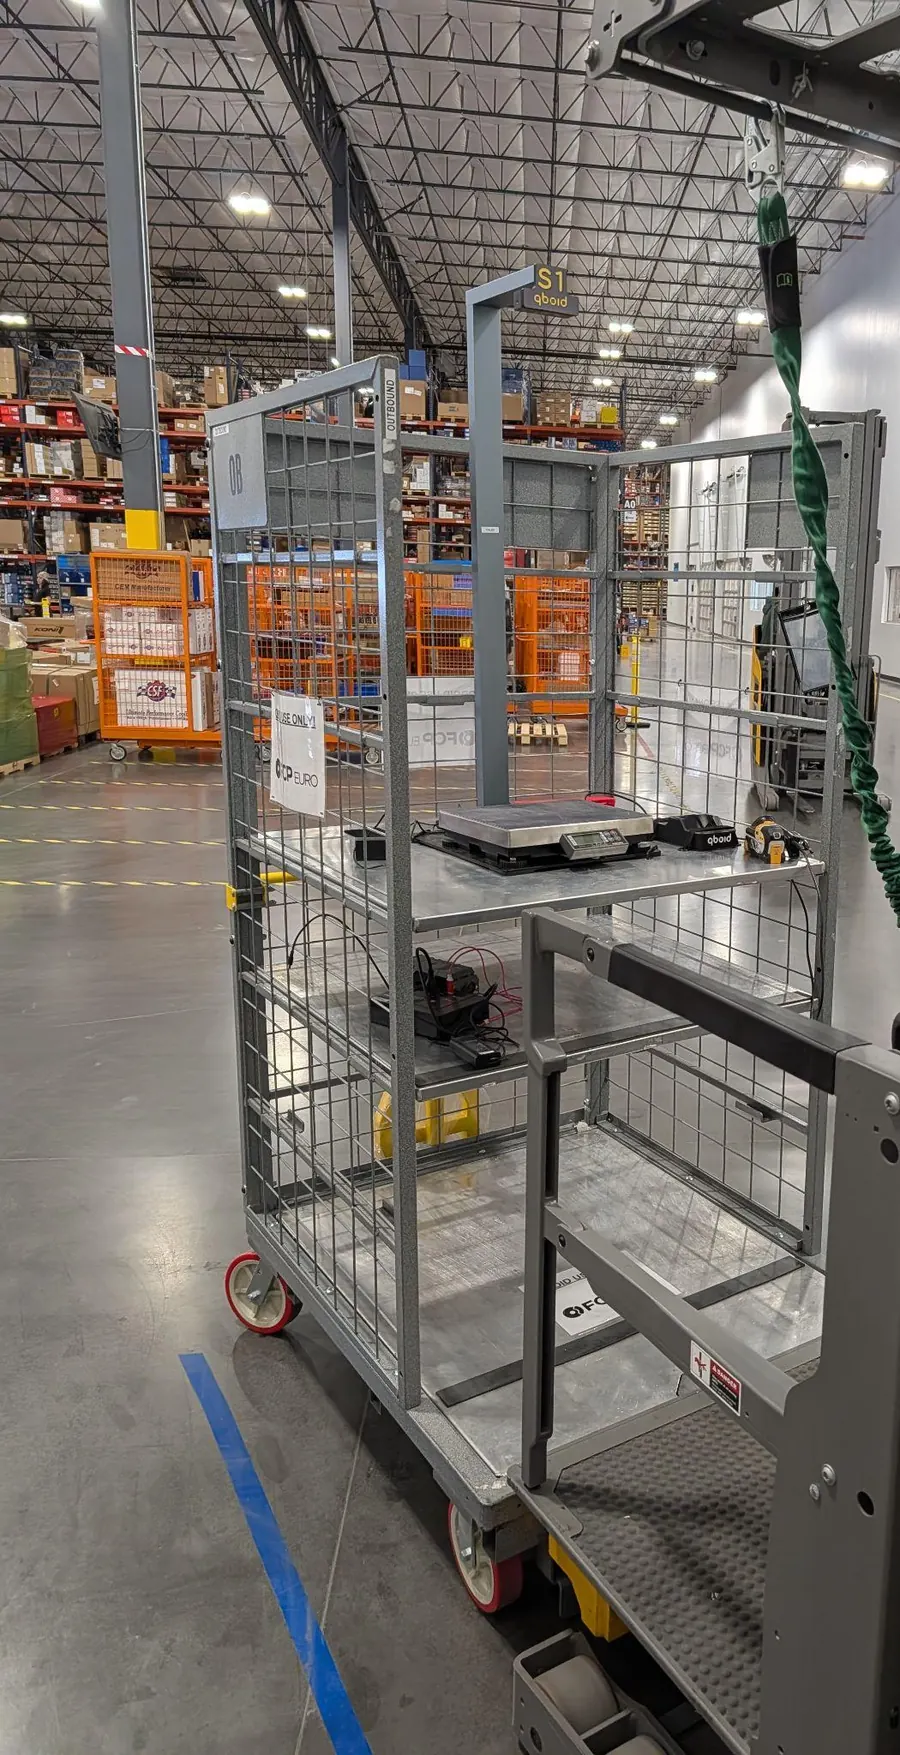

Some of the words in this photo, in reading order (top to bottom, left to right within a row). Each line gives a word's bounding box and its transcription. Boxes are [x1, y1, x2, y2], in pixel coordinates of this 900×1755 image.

[538, 267, 563, 292] S1
[533, 291, 568, 308] qboid
[386, 380, 396, 432] OUTBOUND
[229, 453, 243, 496] OB
[147, 685, 163, 697] CSF
[292, 713, 316, 727] ONLY!
[294, 770, 319, 788] EURO
[707, 833, 732, 846] qboid
[581, 1296, 607, 1311] FC
